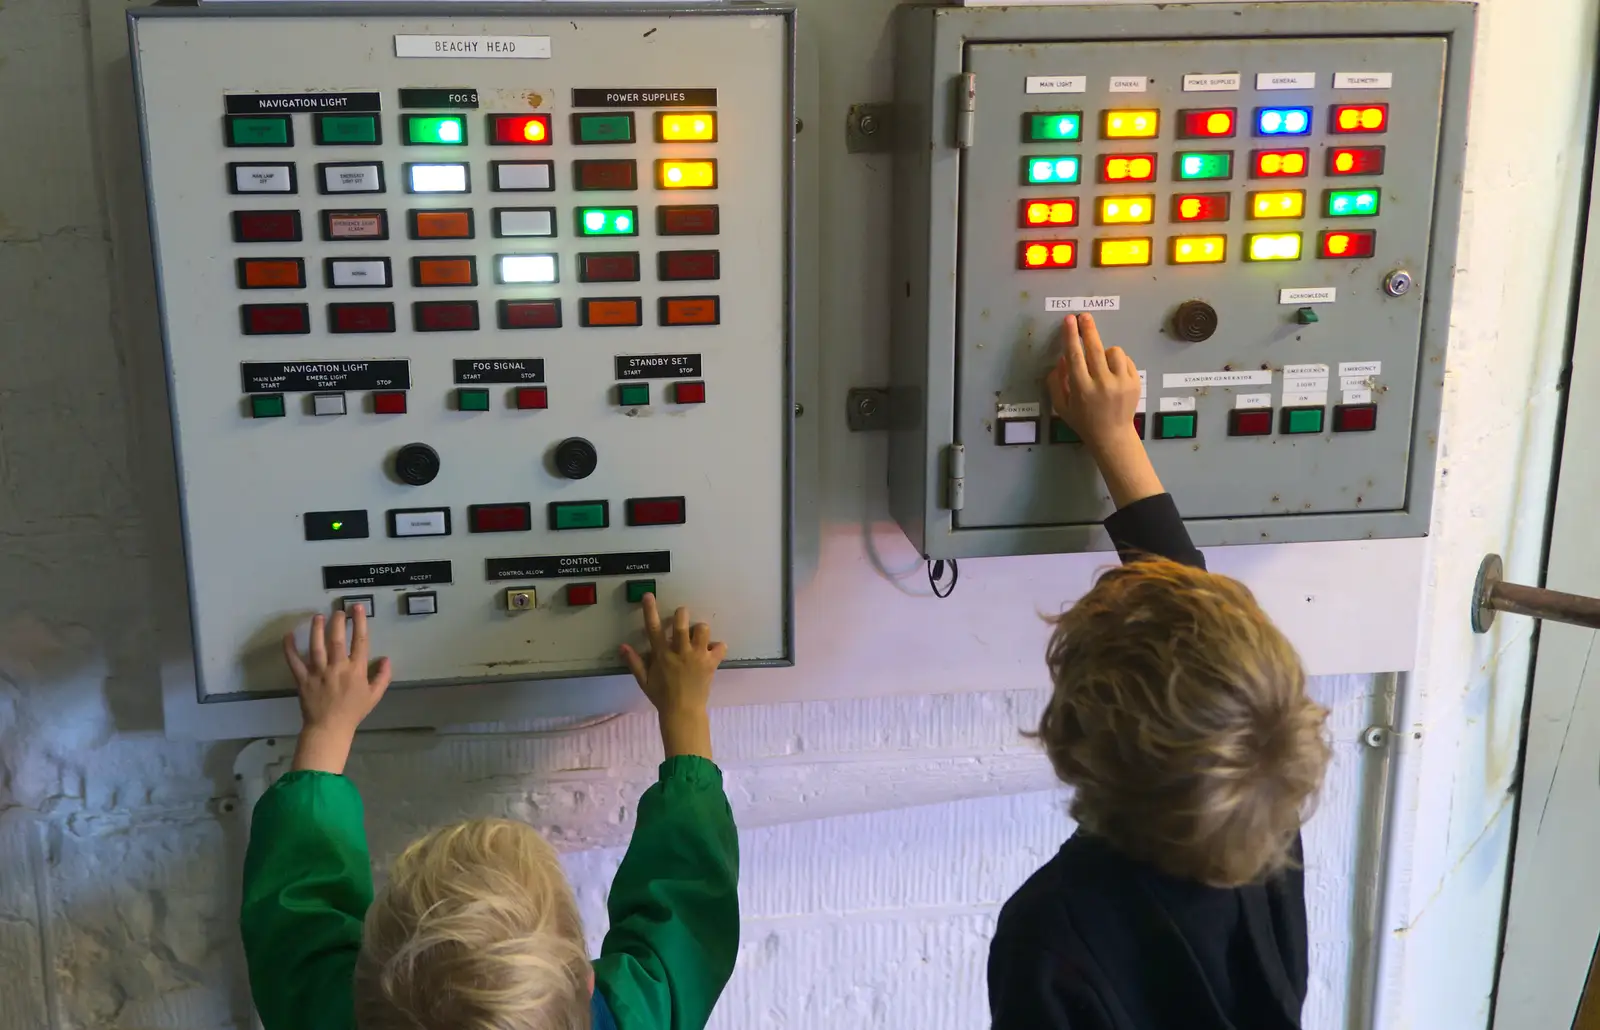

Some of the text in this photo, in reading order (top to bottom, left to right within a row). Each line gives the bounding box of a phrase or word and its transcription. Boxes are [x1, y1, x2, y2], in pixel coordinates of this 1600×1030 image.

[435, 41, 516, 52] BEACHY HEAD
[449, 94, 468, 103] FOG
[606, 93, 686, 102] POWER SUPPLIES
[259, 97, 348, 108] NAVIGATION LIGHT
[1051, 299, 1115, 308] TEST LAMPS
[473, 362, 526, 370] FOG SIGNAL
[629, 357, 688, 367] STANDBY SET
[283, 363, 369, 373] NAVIGATION LIGHT
[560, 557, 600, 566] CONTROL
[369, 566, 406, 575] DISPLAY
